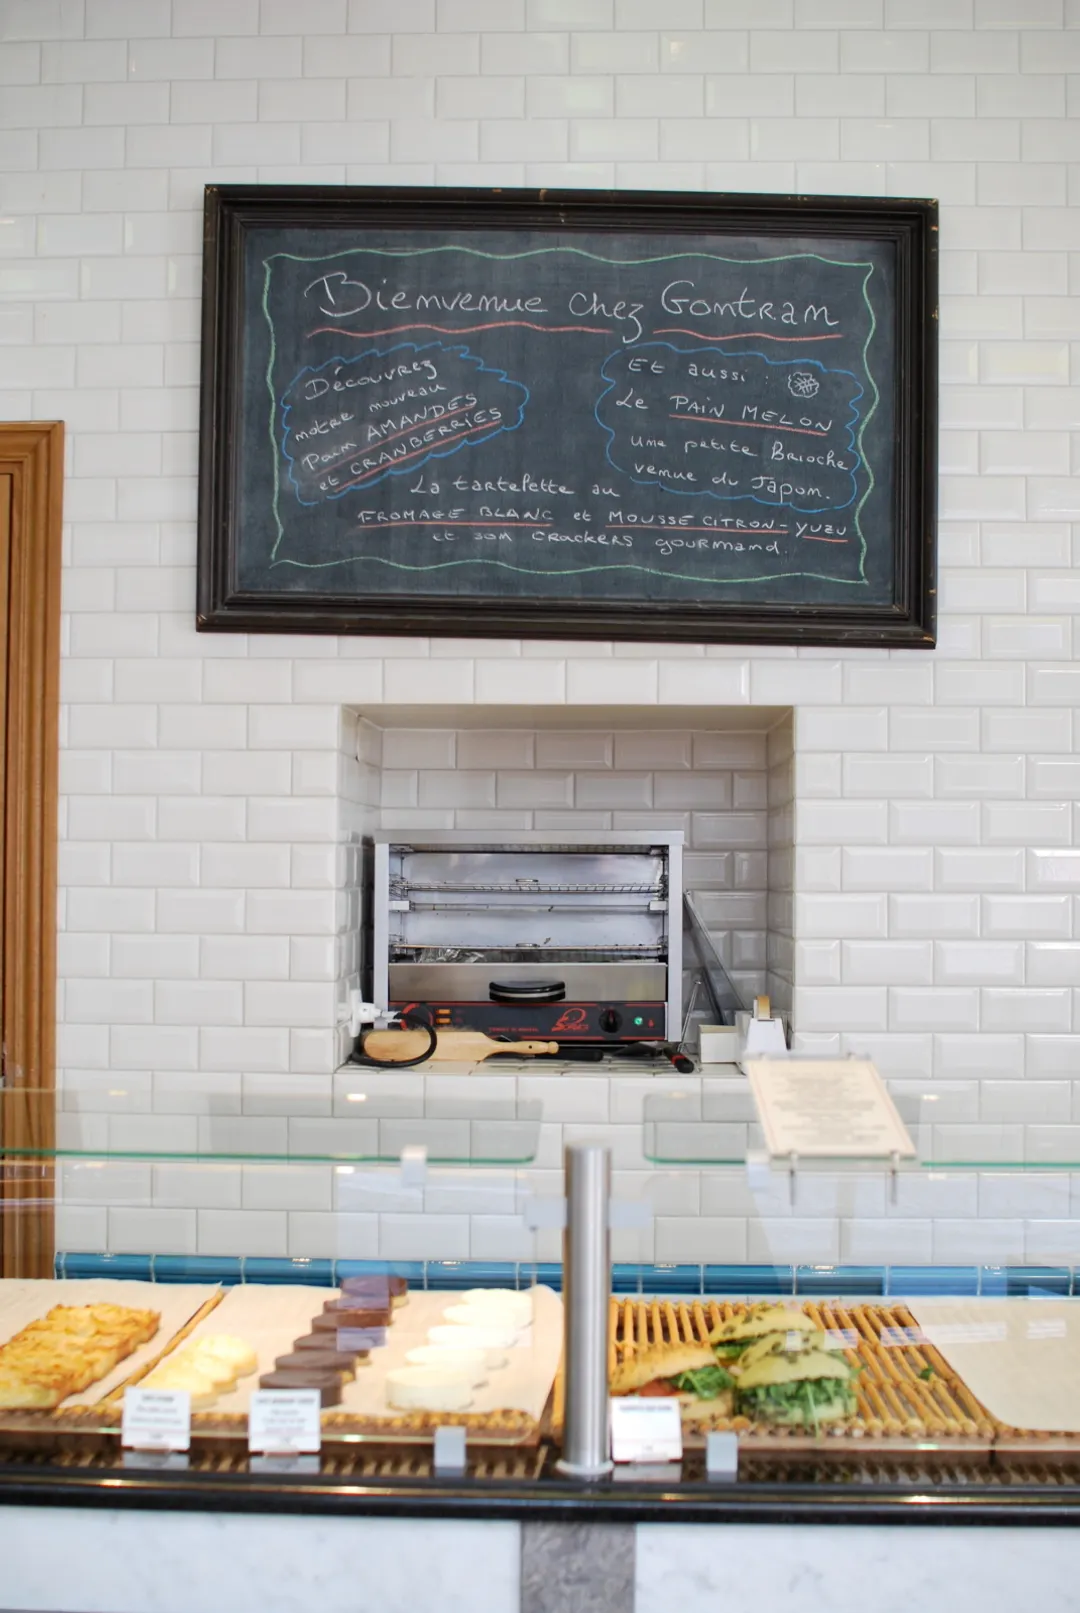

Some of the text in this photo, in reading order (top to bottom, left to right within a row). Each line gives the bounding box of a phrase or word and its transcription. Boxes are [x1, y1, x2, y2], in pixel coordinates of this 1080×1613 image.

[366, 392, 478, 443] AMANDES
[615, 388, 649, 411] Le
[741, 405, 833, 432] MELON
[683, 437, 759, 457] petite
[410, 473, 621, 497] La tartelette au
[711, 472, 740, 487] du
[356, 508, 466, 523] FROMAGE
[479, 506, 555, 521] BLANC
[608, 510, 696, 526] MOUSSE
